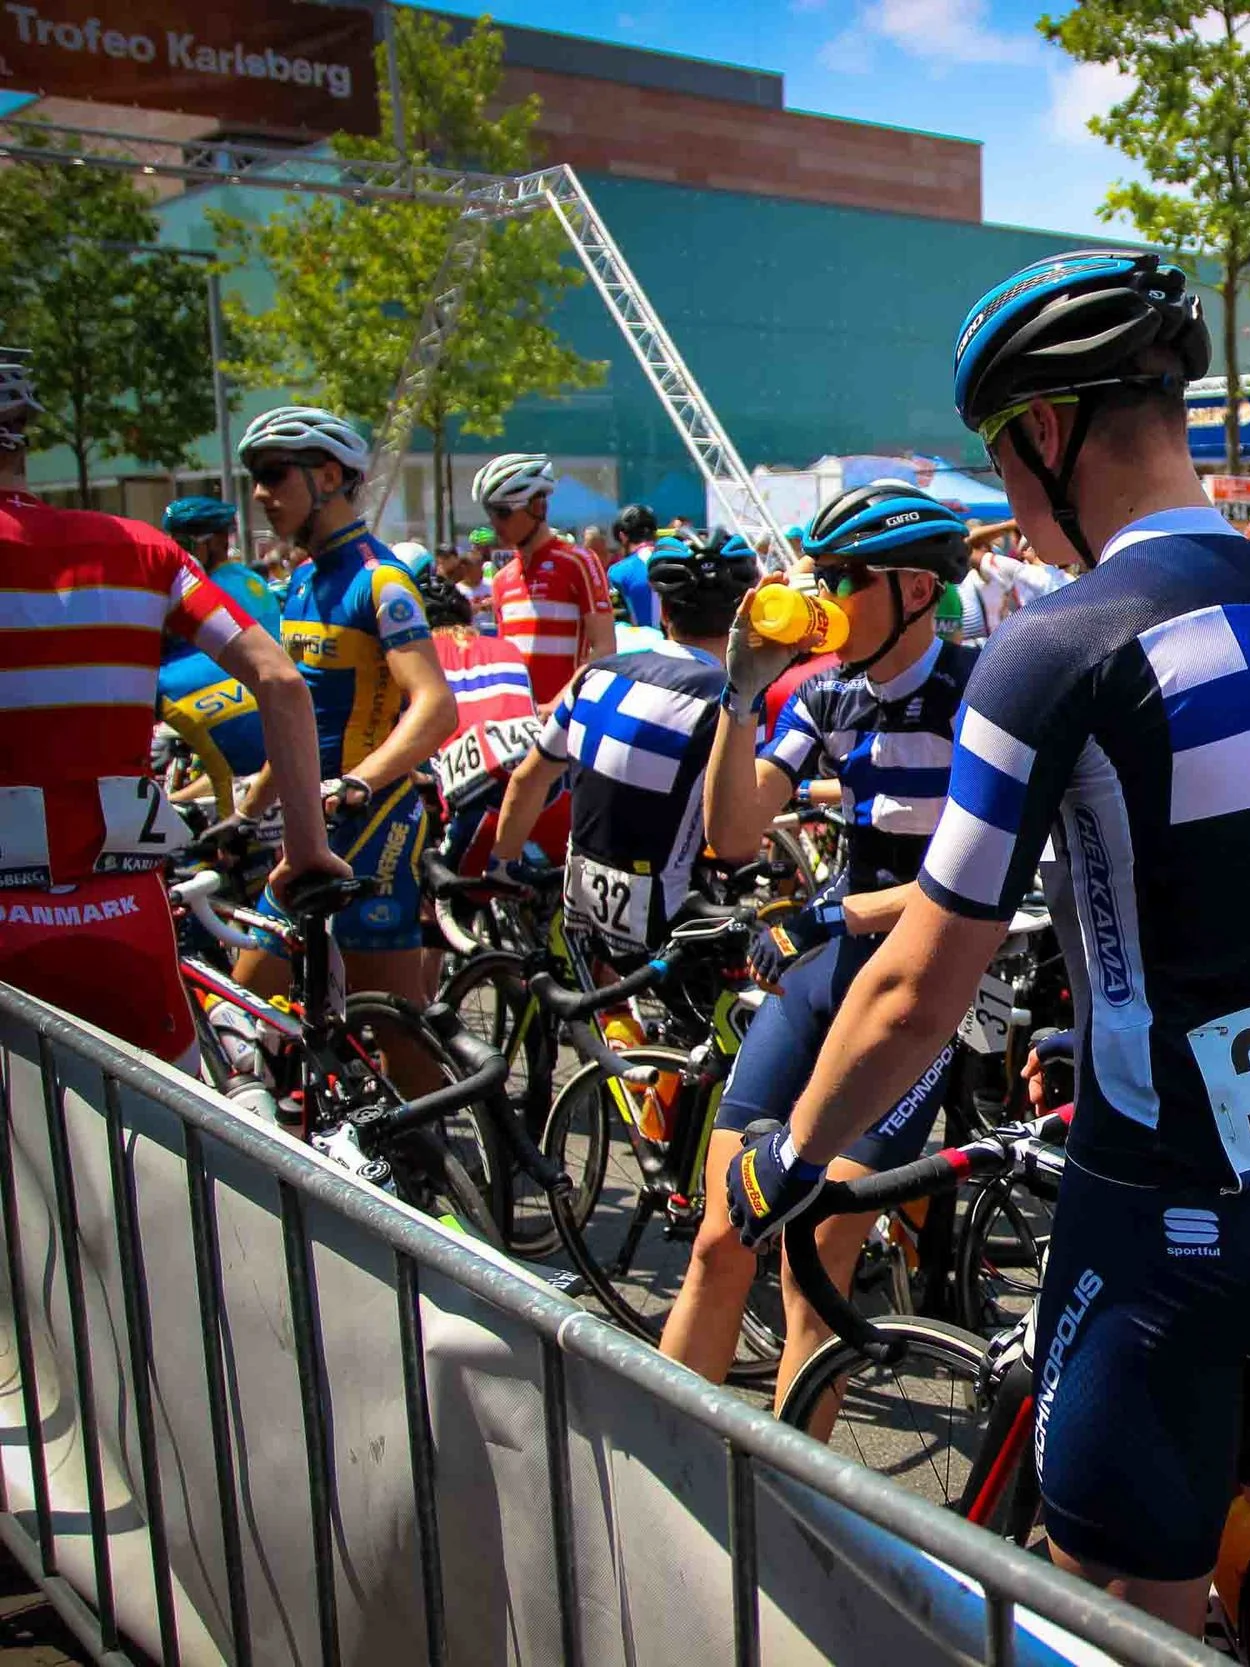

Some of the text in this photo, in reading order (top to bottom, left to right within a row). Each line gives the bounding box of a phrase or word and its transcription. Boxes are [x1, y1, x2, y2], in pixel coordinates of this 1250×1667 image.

[6, 3, 351, 98] Trofeo Karlsberg
[957, 313, 984, 362] GIRO
[885, 511, 920, 527] GIRO
[408, 553, 421, 600] GIRO
[194, 685, 244, 718] SV
[443, 733, 480, 785] 146
[136, 775, 166, 844] 2
[122, 857, 162, 871] KARL
[592, 873, 631, 934] 32
[1077, 812, 1127, 992] HELKAMA
[963, 1006, 975, 1035] KARL
[975, 988, 1013, 1036] 31
[878, 1045, 955, 1137] TECHNOPO
[743, 1154, 769, 1215] PowerBar
[1166, 1246, 1221, 1258] sportful
